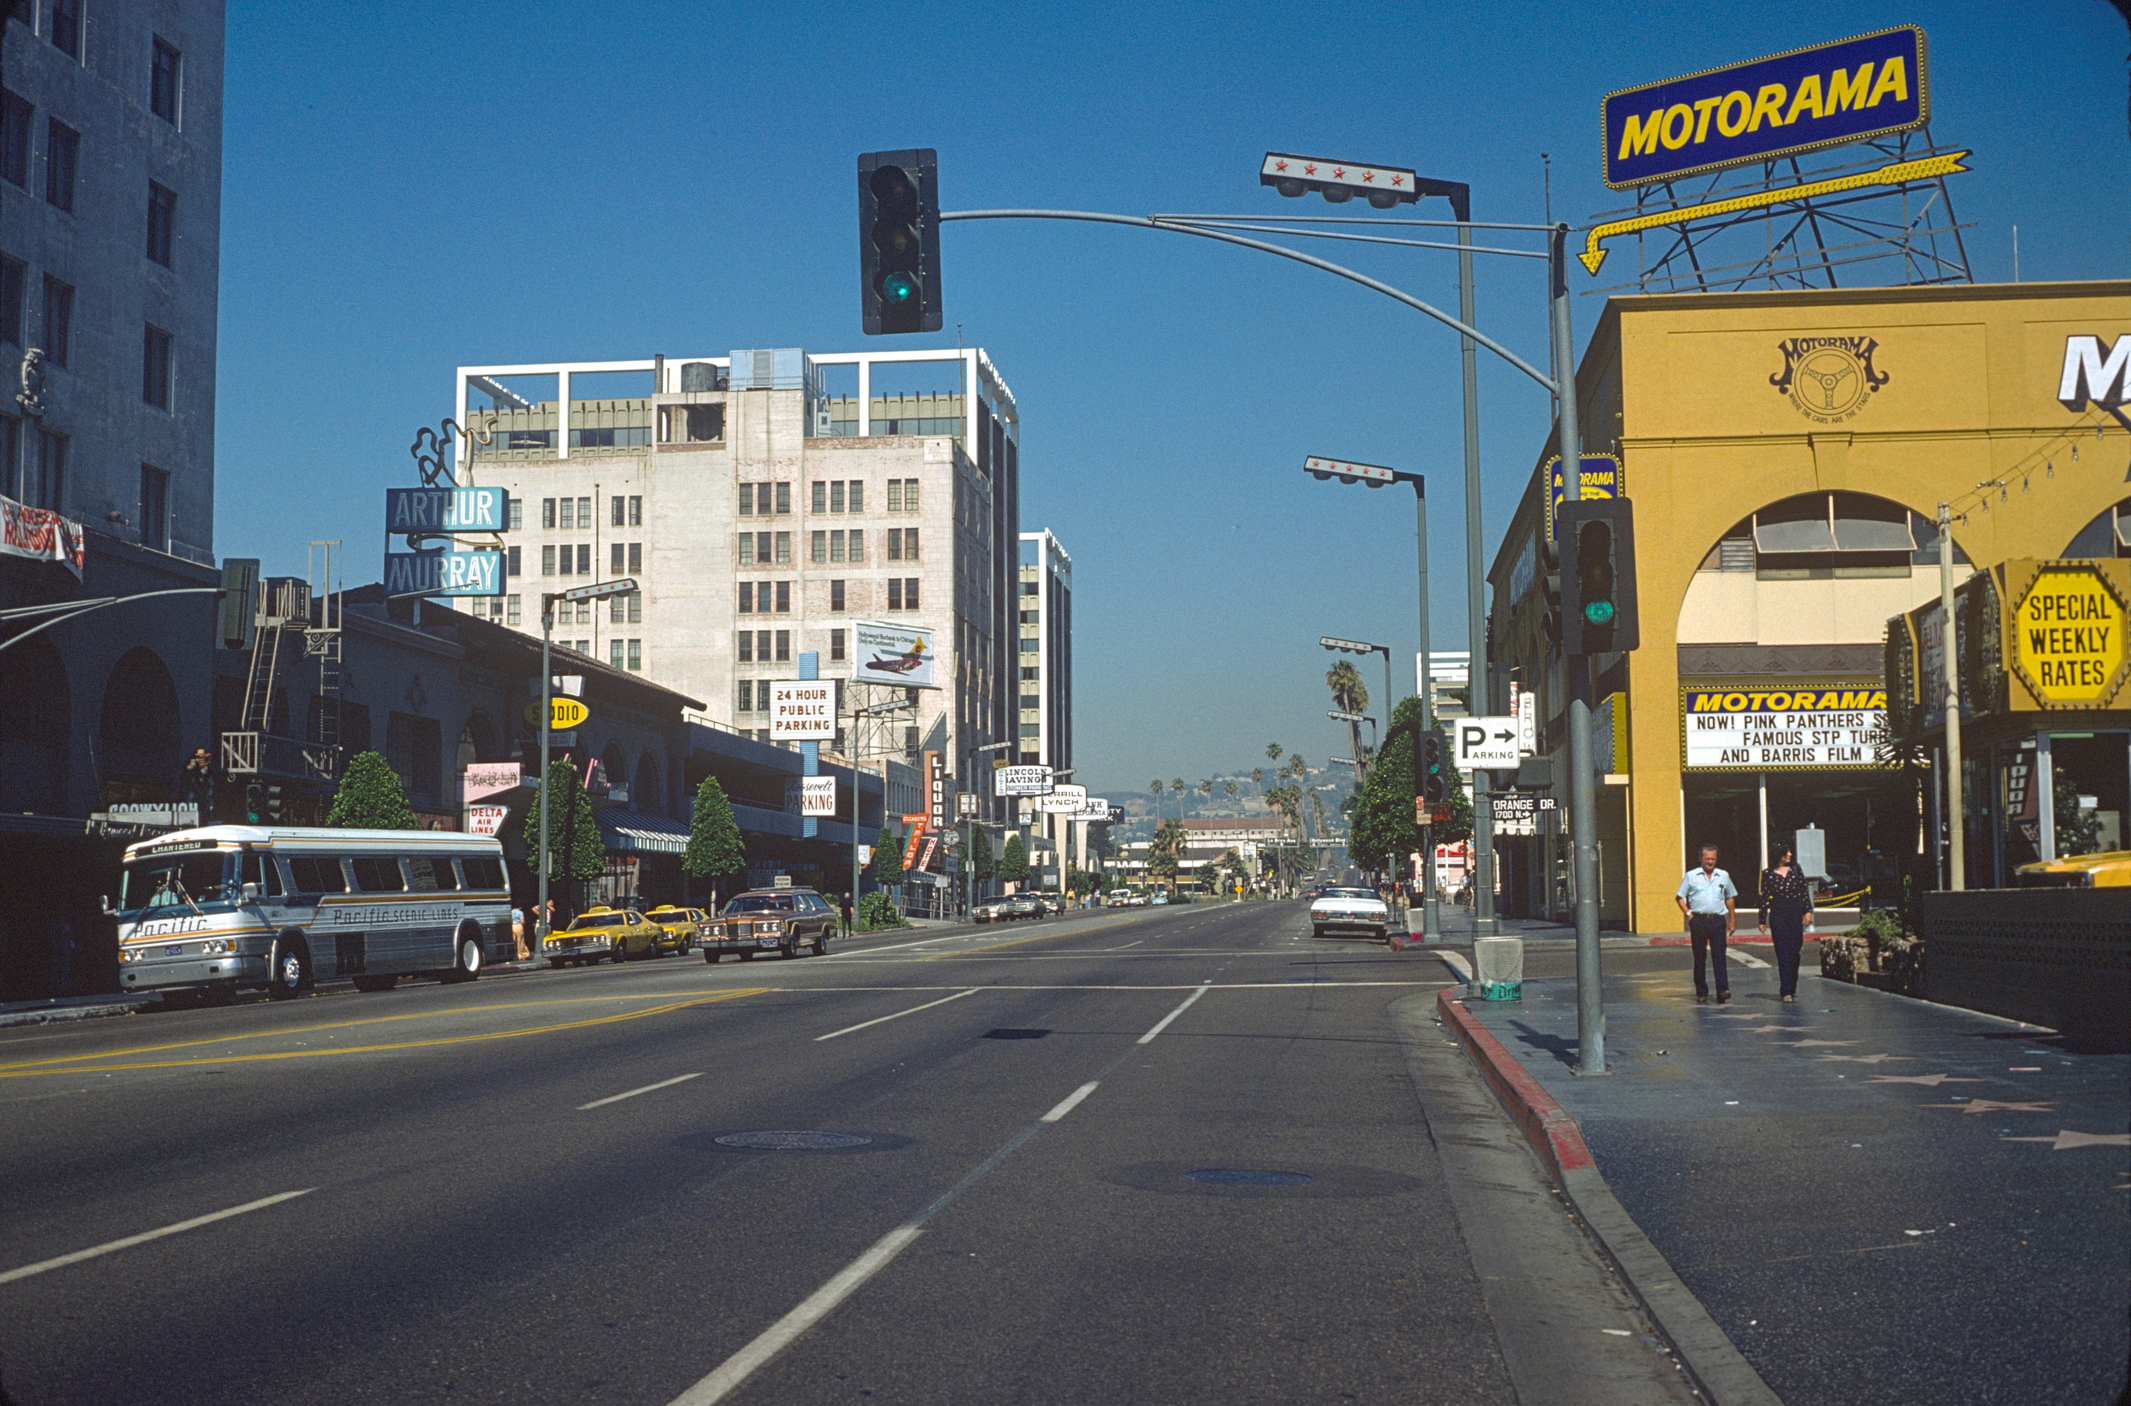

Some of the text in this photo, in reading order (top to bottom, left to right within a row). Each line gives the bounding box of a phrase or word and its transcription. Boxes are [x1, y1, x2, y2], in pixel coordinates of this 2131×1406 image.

[1617, 55, 1908, 161] MOTORAMA
[1769, 336, 1890, 394] MOTORAMA
[1787, 391, 1871, 424] WHERE THE CARS ARE THE STARS
[1554, 471, 1614, 488] MORAMA
[393, 491, 493, 526] ARTHUR
[387, 556, 497, 591] MURRAY
[2030, 594, 2112, 621] SPECIAL
[2029, 627, 2110, 655] WEEKLY
[2041, 661, 2105, 686] RATES
[777, 690, 827, 700] 24 HOUR
[779, 705, 825, 716] PUBLIC
[776, 720, 830, 731] PARKING
[1697, 715, 1735, 730] NOW!
[1744, 714, 1777, 729] PINK
[1786, 713, 1864, 728] PANTHERS
[1743, 730, 1803, 746] FAMOUS
[1812, 730, 1840, 745] STP
[1720, 749, 1749, 763] AND
[1762, 748, 1815, 762] BARRIS
[1828, 747, 1862, 761] FILM
[787, 780, 833, 792] Roosevelt
[932, 756, 943, 827] LIQUOR
[787, 794, 833, 810] PARKING
[1493, 798, 1556, 810] ORANGE DR.
[471, 808, 503, 818] DELTA
[1495, 810, 1513, 818] 1700
[904, 822, 924, 866] TAILOR
[333, 908, 458, 925] Pacific SCENIC LINES
[133, 917, 212, 938] Pacific
